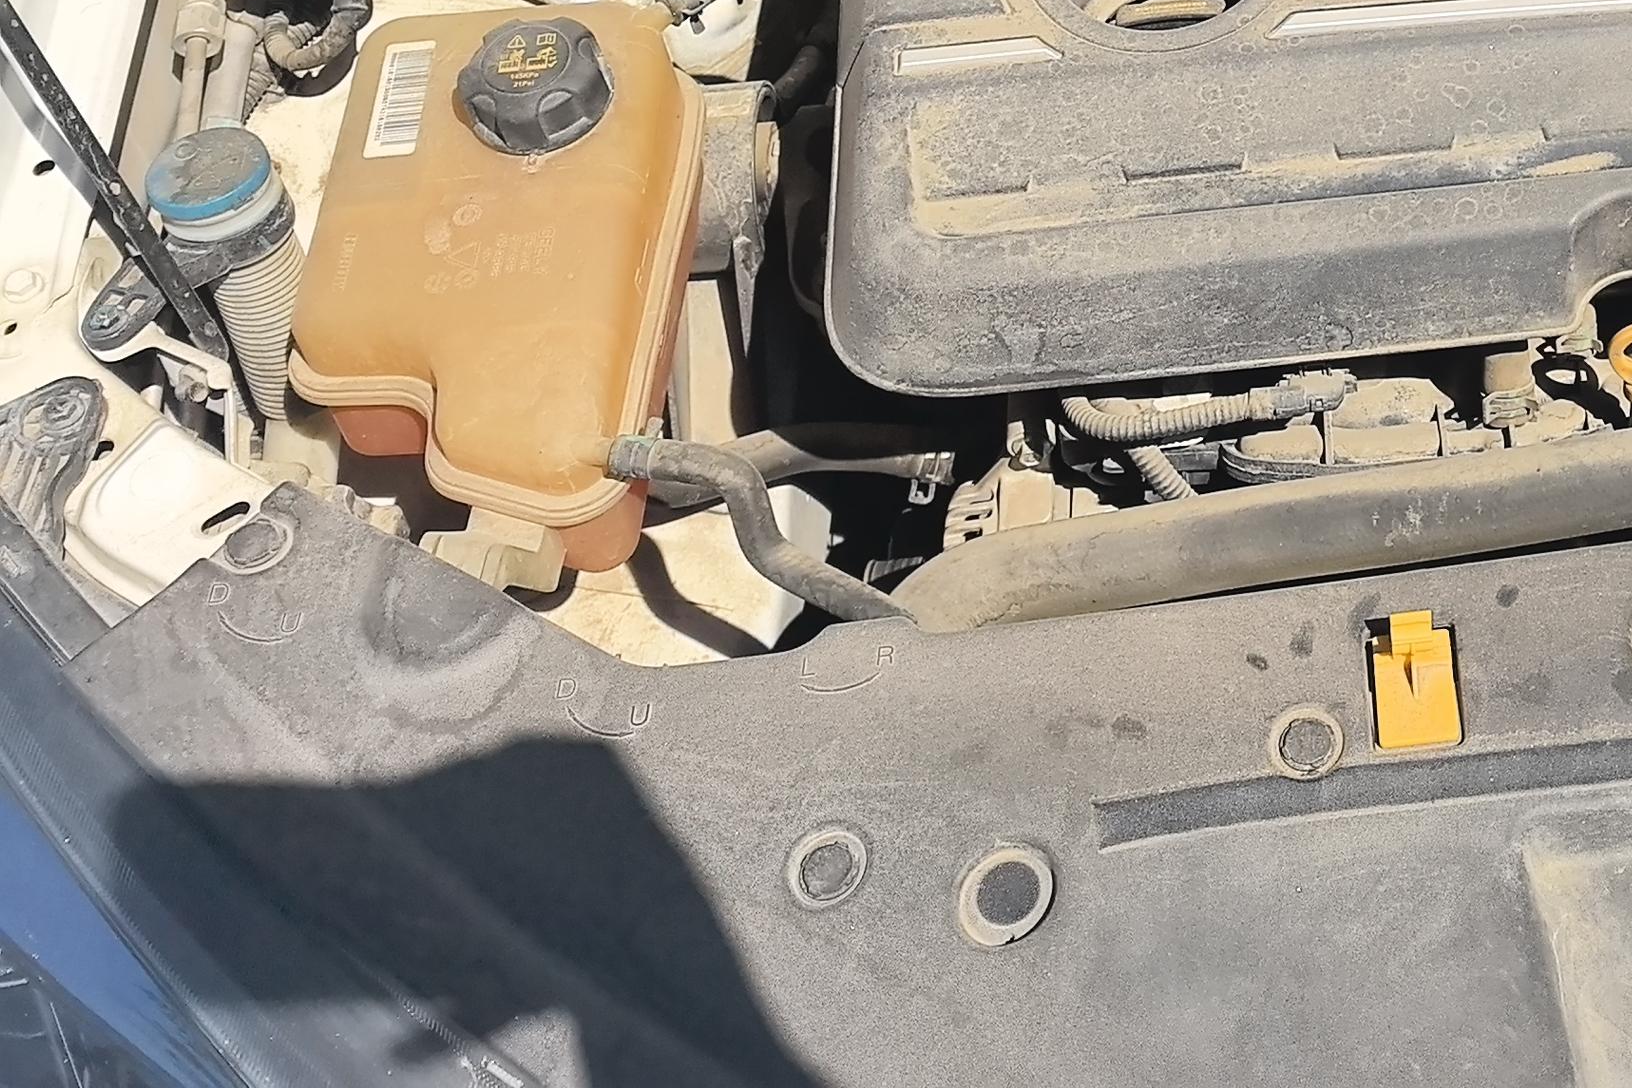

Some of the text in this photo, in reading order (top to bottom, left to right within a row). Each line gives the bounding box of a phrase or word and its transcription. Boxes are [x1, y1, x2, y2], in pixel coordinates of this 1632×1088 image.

[208, 582, 230, 605] D
[280, 612, 303, 634] U
[876, 645, 895, 666] R
[800, 657, 816, 678] L
[555, 677, 578, 700] D
[630, 703, 652, 727] U
